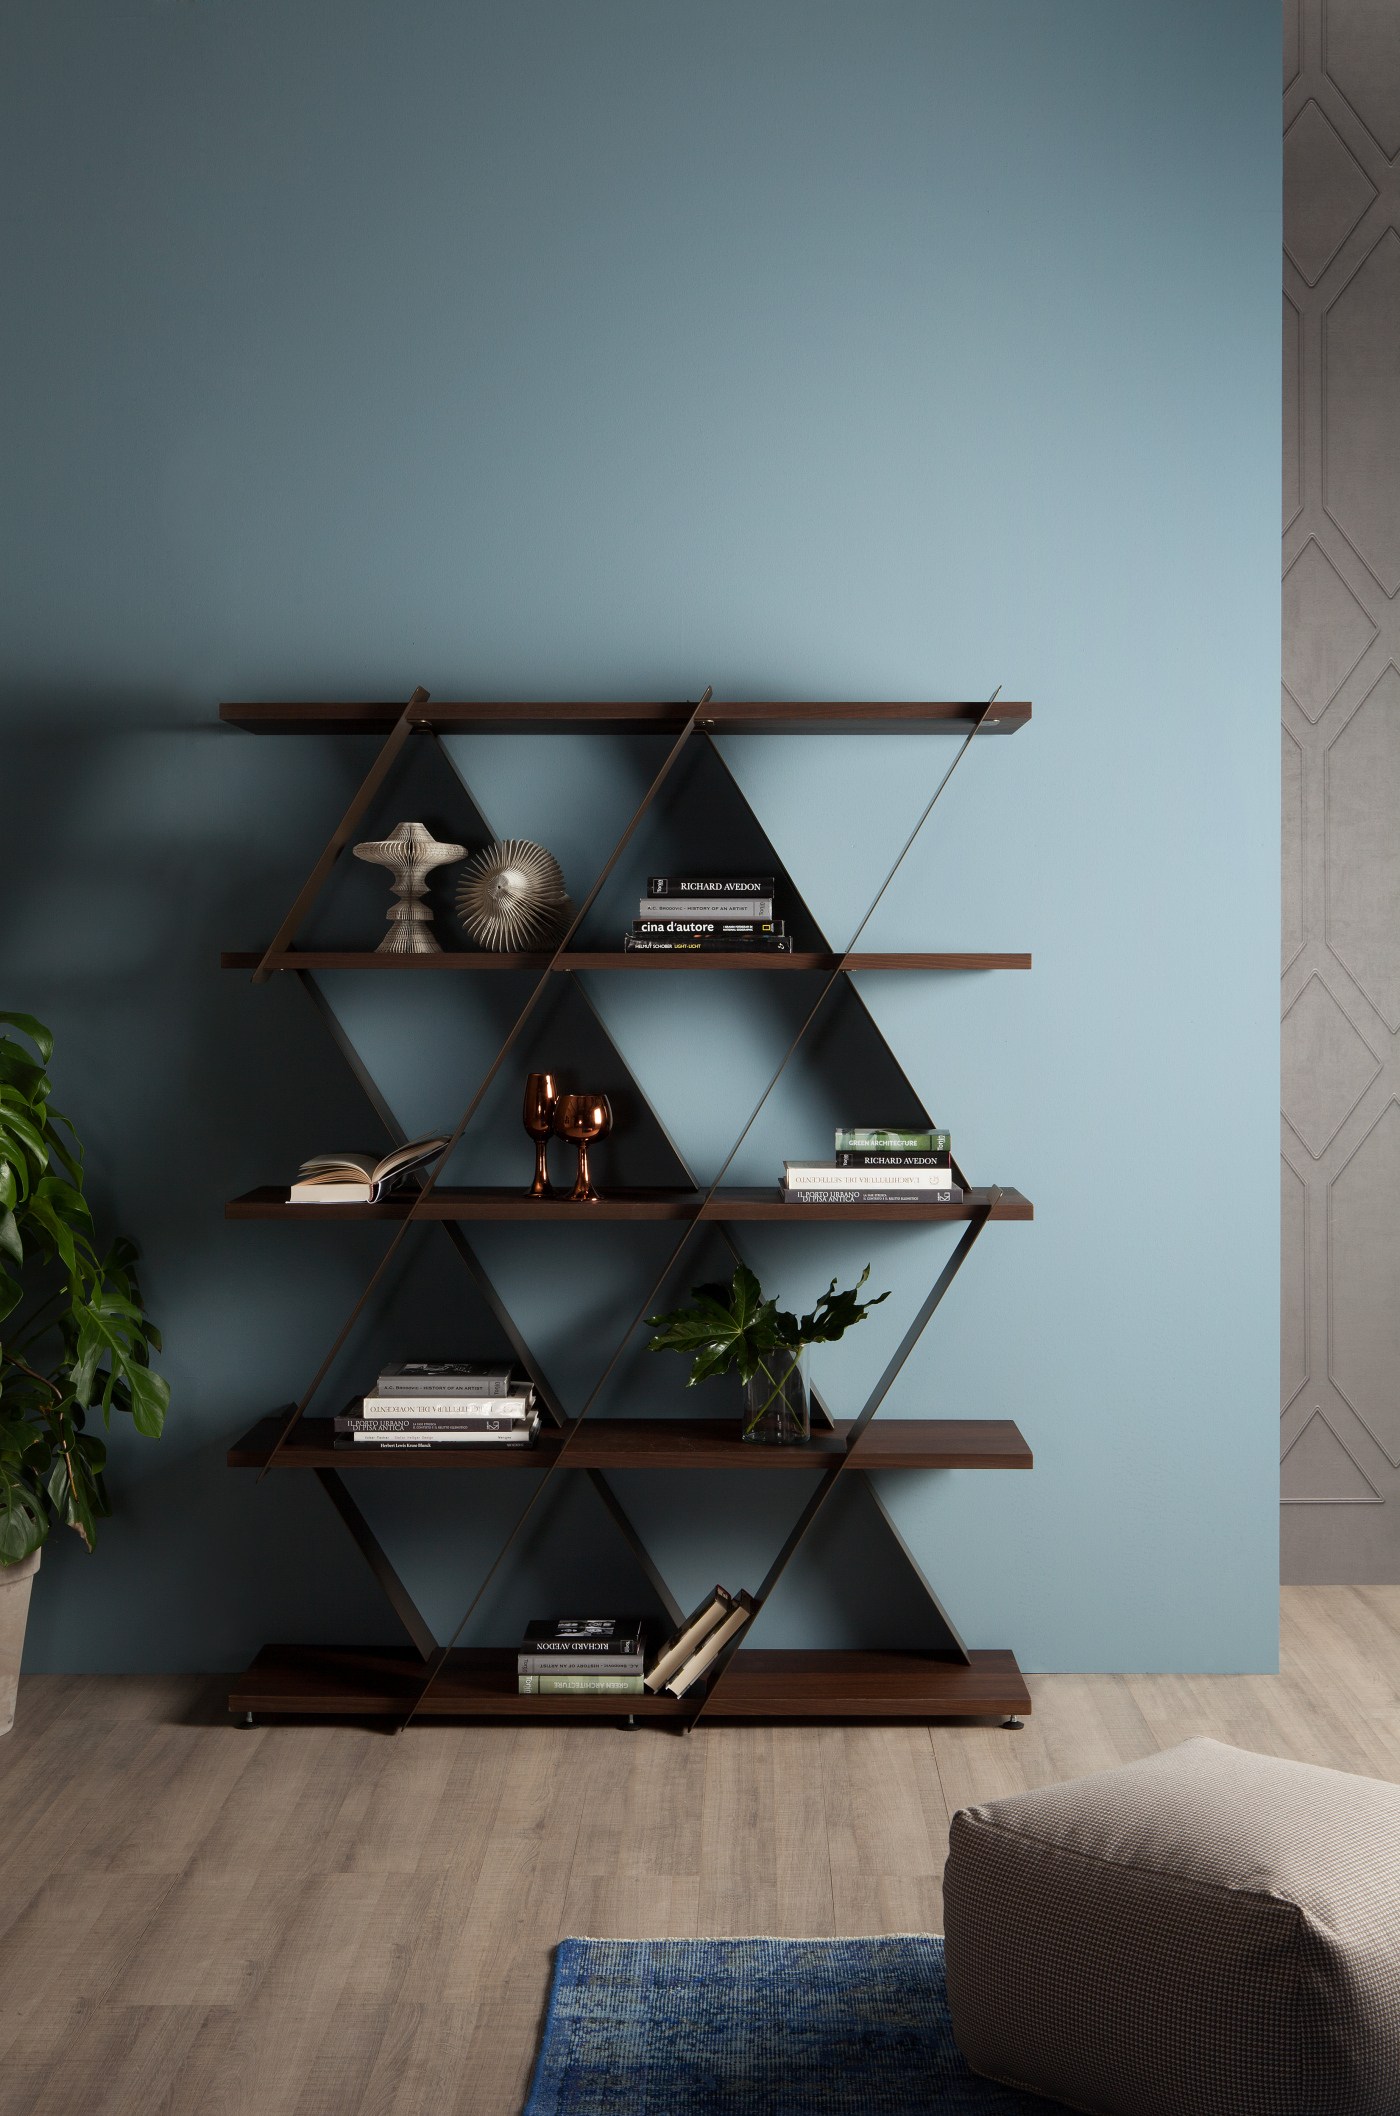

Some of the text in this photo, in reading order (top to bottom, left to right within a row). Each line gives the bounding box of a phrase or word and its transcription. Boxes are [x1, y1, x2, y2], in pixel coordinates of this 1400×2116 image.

[681, 882, 761, 891] RICHARD AVEDON
[641, 921, 714, 932] cina d'autore
[864, 1157, 938, 1165] RICHARD AVEDON
[795, 1176, 842, 1184] SETTECENTO
[845, 1176, 857, 1184] DEL
